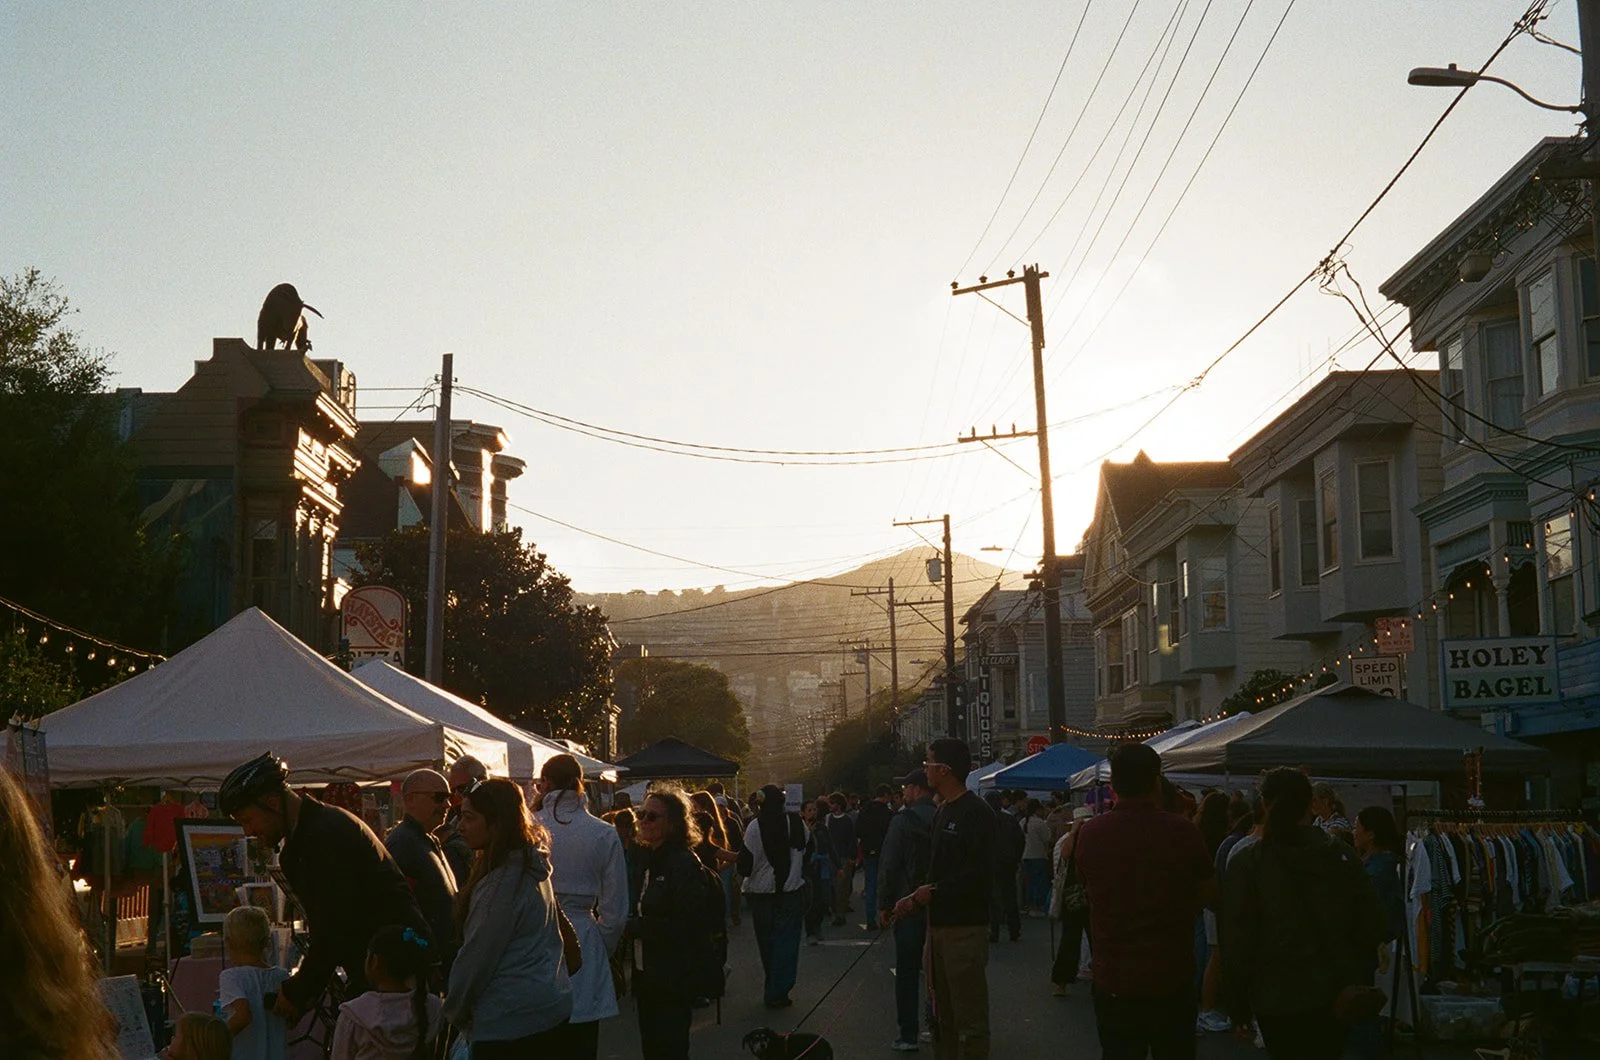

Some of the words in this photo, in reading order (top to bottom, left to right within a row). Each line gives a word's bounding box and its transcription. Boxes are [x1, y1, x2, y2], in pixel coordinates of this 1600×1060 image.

[1354, 663, 1397, 674] SPEED
[1449, 645, 1550, 669] HOLEY
[1359, 675, 1393, 686] LIMIT
[1453, 676, 1552, 699] BAGEL
[979, 666, 991, 757] LIQUORS
